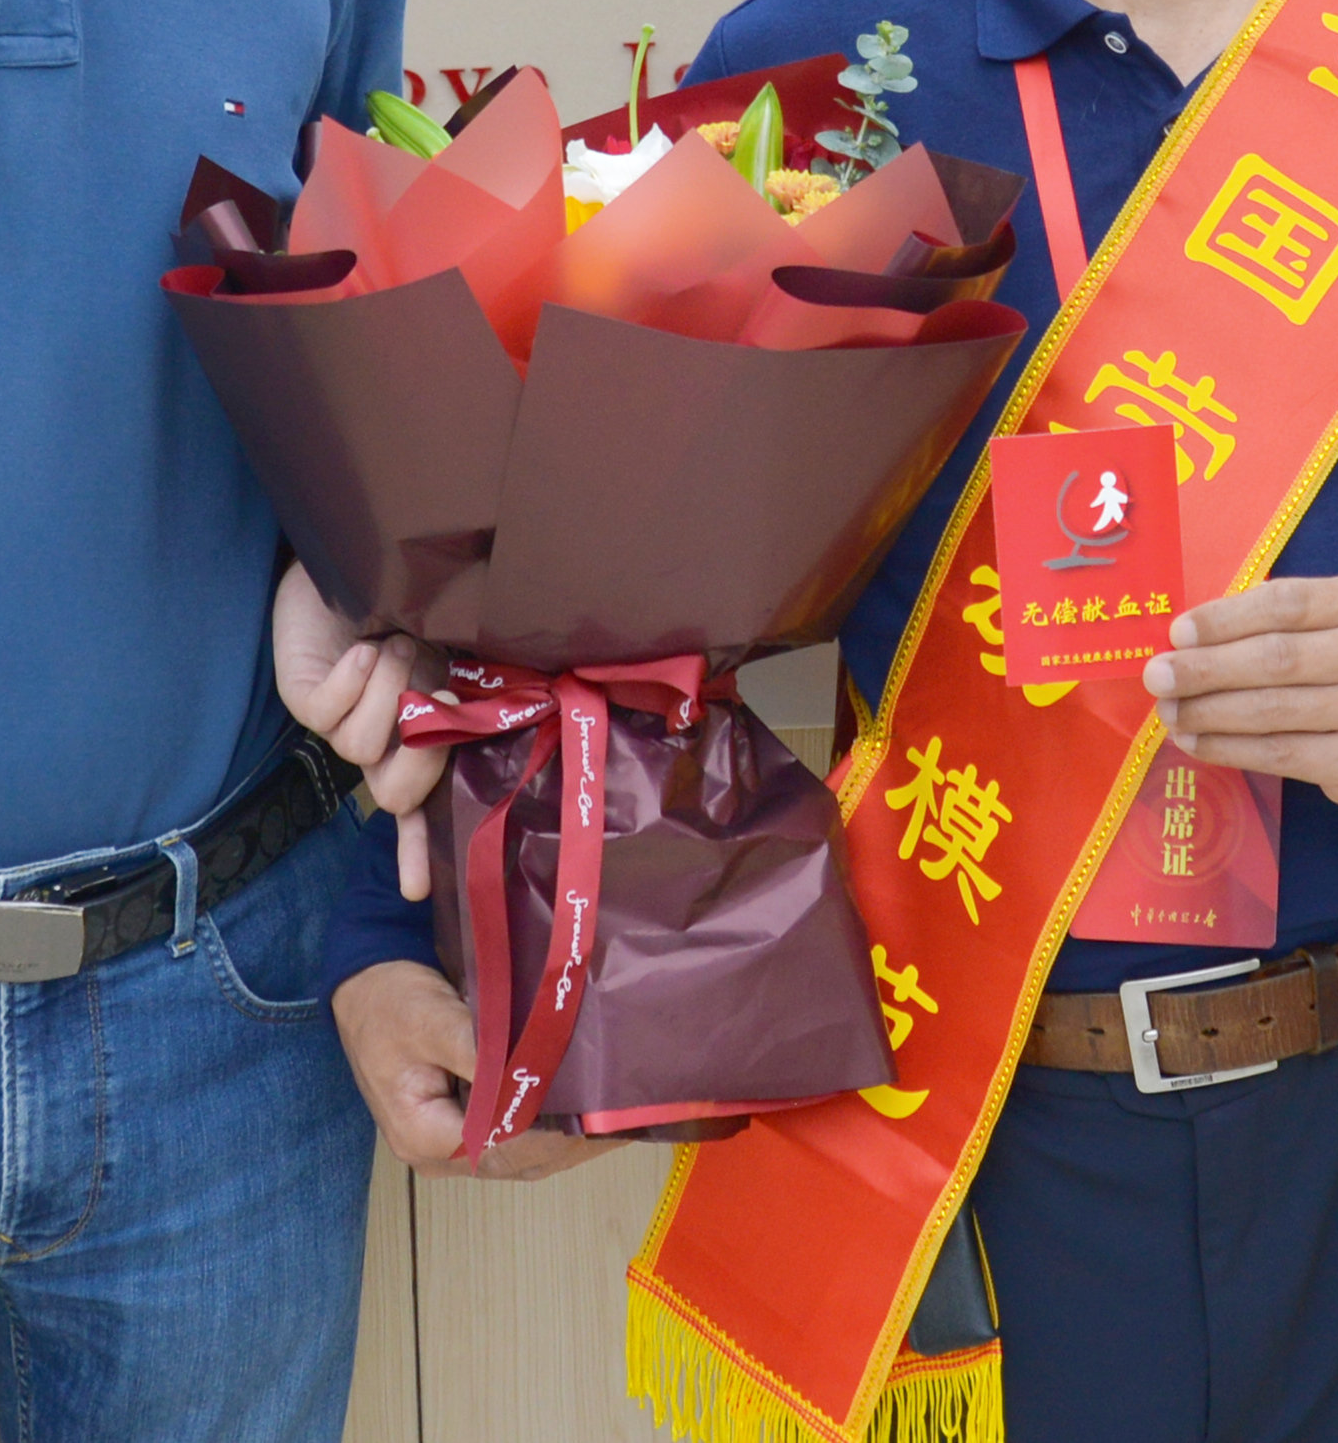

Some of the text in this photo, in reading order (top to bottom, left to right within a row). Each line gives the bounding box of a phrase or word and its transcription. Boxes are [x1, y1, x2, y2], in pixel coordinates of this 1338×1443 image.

[1021, 592, 1172, 626] 无偿献血证
[1041, 646, 1154, 667] 国家卫生健康委员会监制
[1161, 766, 1197, 878] 出席证
